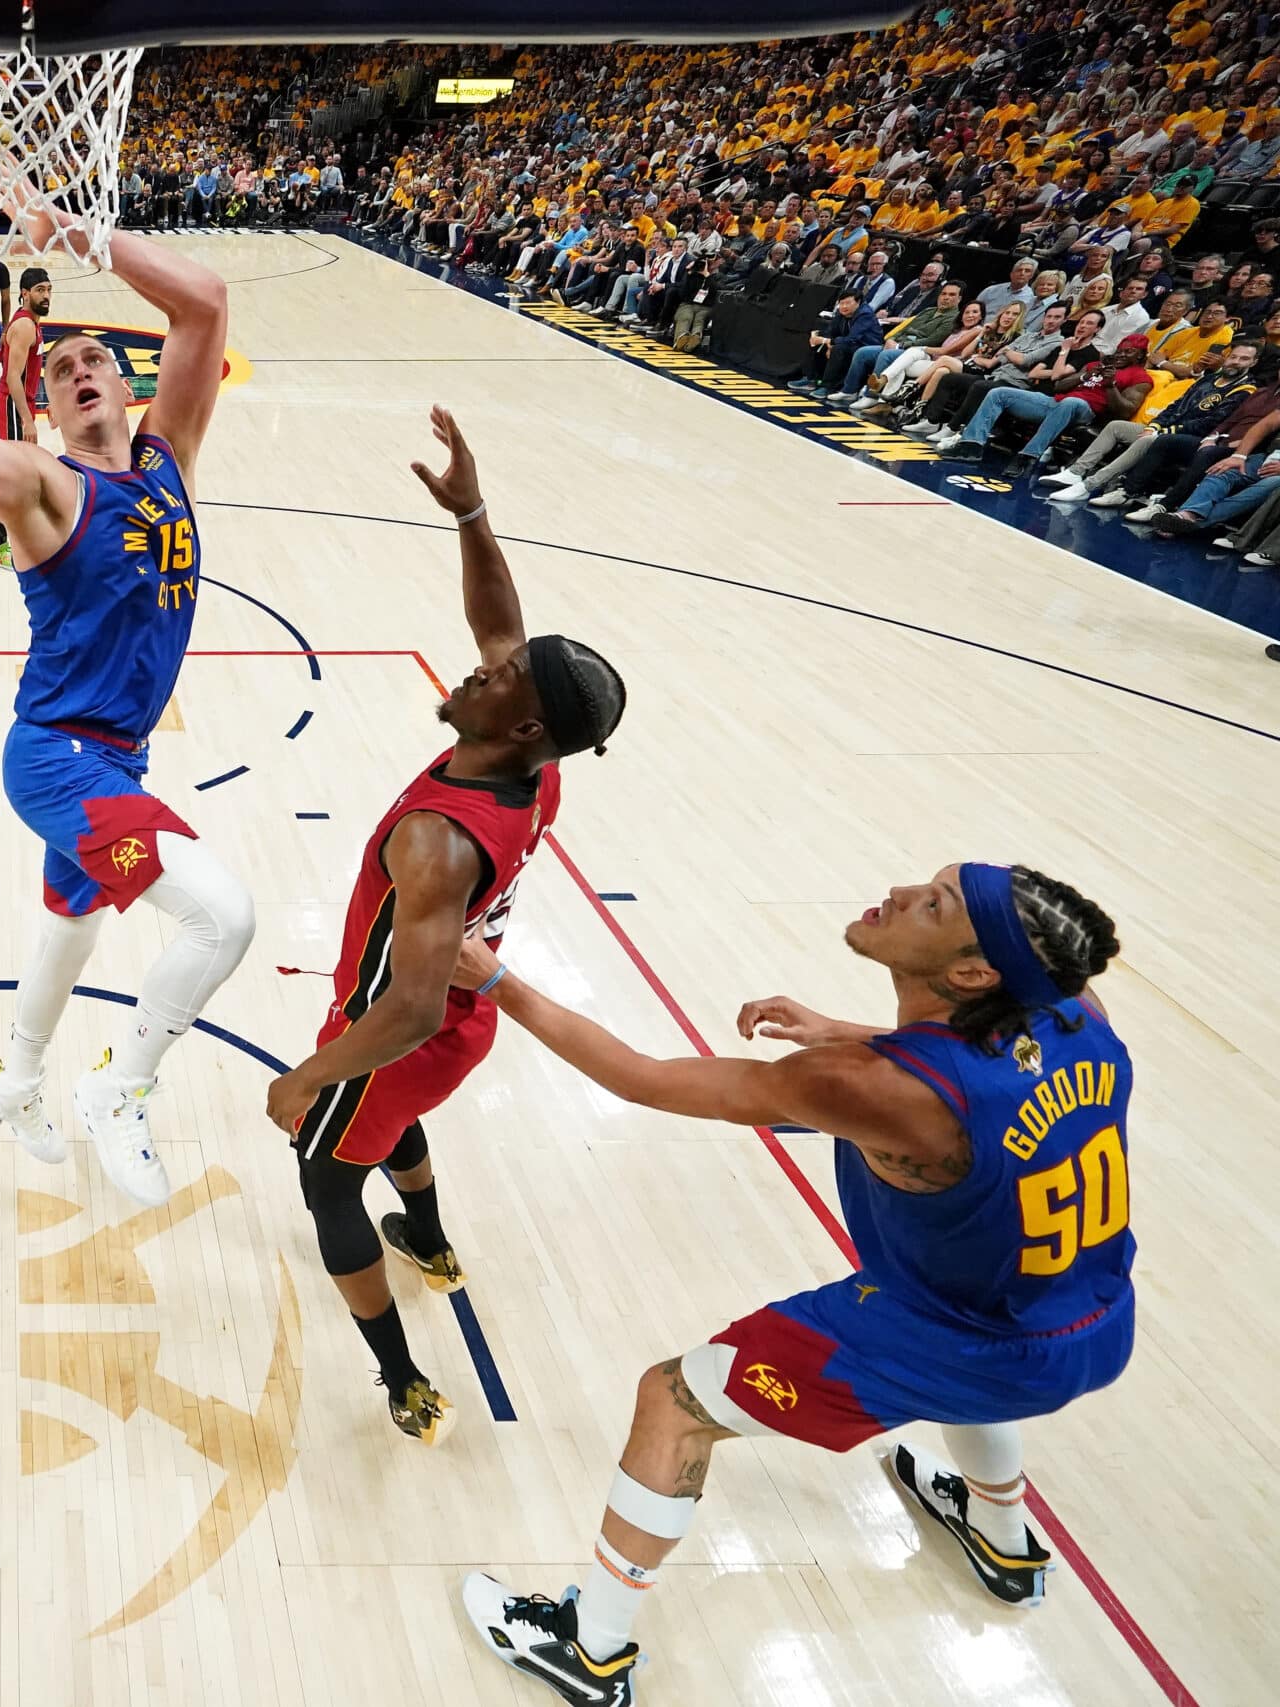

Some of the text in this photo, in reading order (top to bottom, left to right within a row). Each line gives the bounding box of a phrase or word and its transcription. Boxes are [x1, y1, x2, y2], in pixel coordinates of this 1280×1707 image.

[669, 369, 824, 408] HIGH
[138, 447, 156, 469] WU
[768, 410, 944, 462] MILE
[158, 516, 193, 574] 15
[157, 575, 197, 610] CITY
[1002, 1060, 1116, 1161] GORDON
[1017, 1122, 1130, 1276] 50
